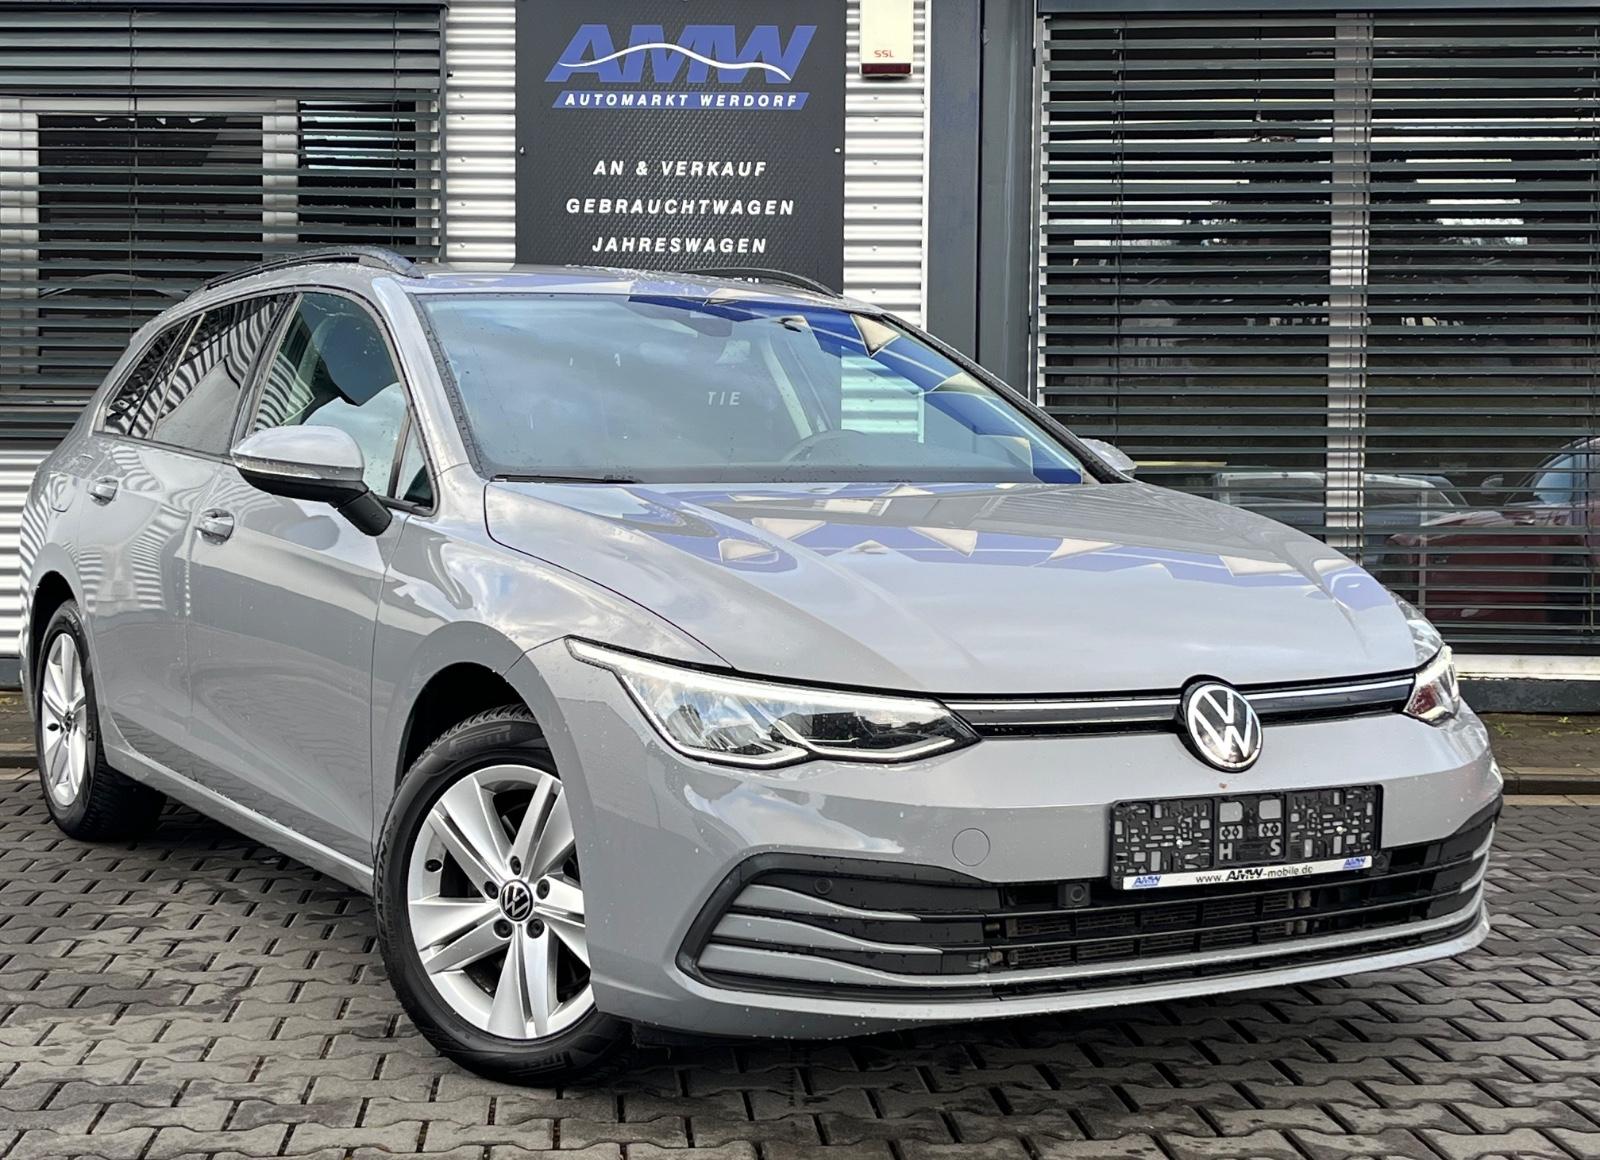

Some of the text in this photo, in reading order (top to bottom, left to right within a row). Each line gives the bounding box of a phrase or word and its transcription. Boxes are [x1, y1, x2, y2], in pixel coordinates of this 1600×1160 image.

[545, 23, 817, 84] AMW
[873, 49, 895, 59] SSL
[565, 93, 797, 108] AUTOMARKT WERDORF
[593, 160, 767, 177] AN & VERKAUF
[566, 198, 794, 216] GEBRAUCHTWAGEN
[592, 236, 766, 254] JAHRESWAGEN
